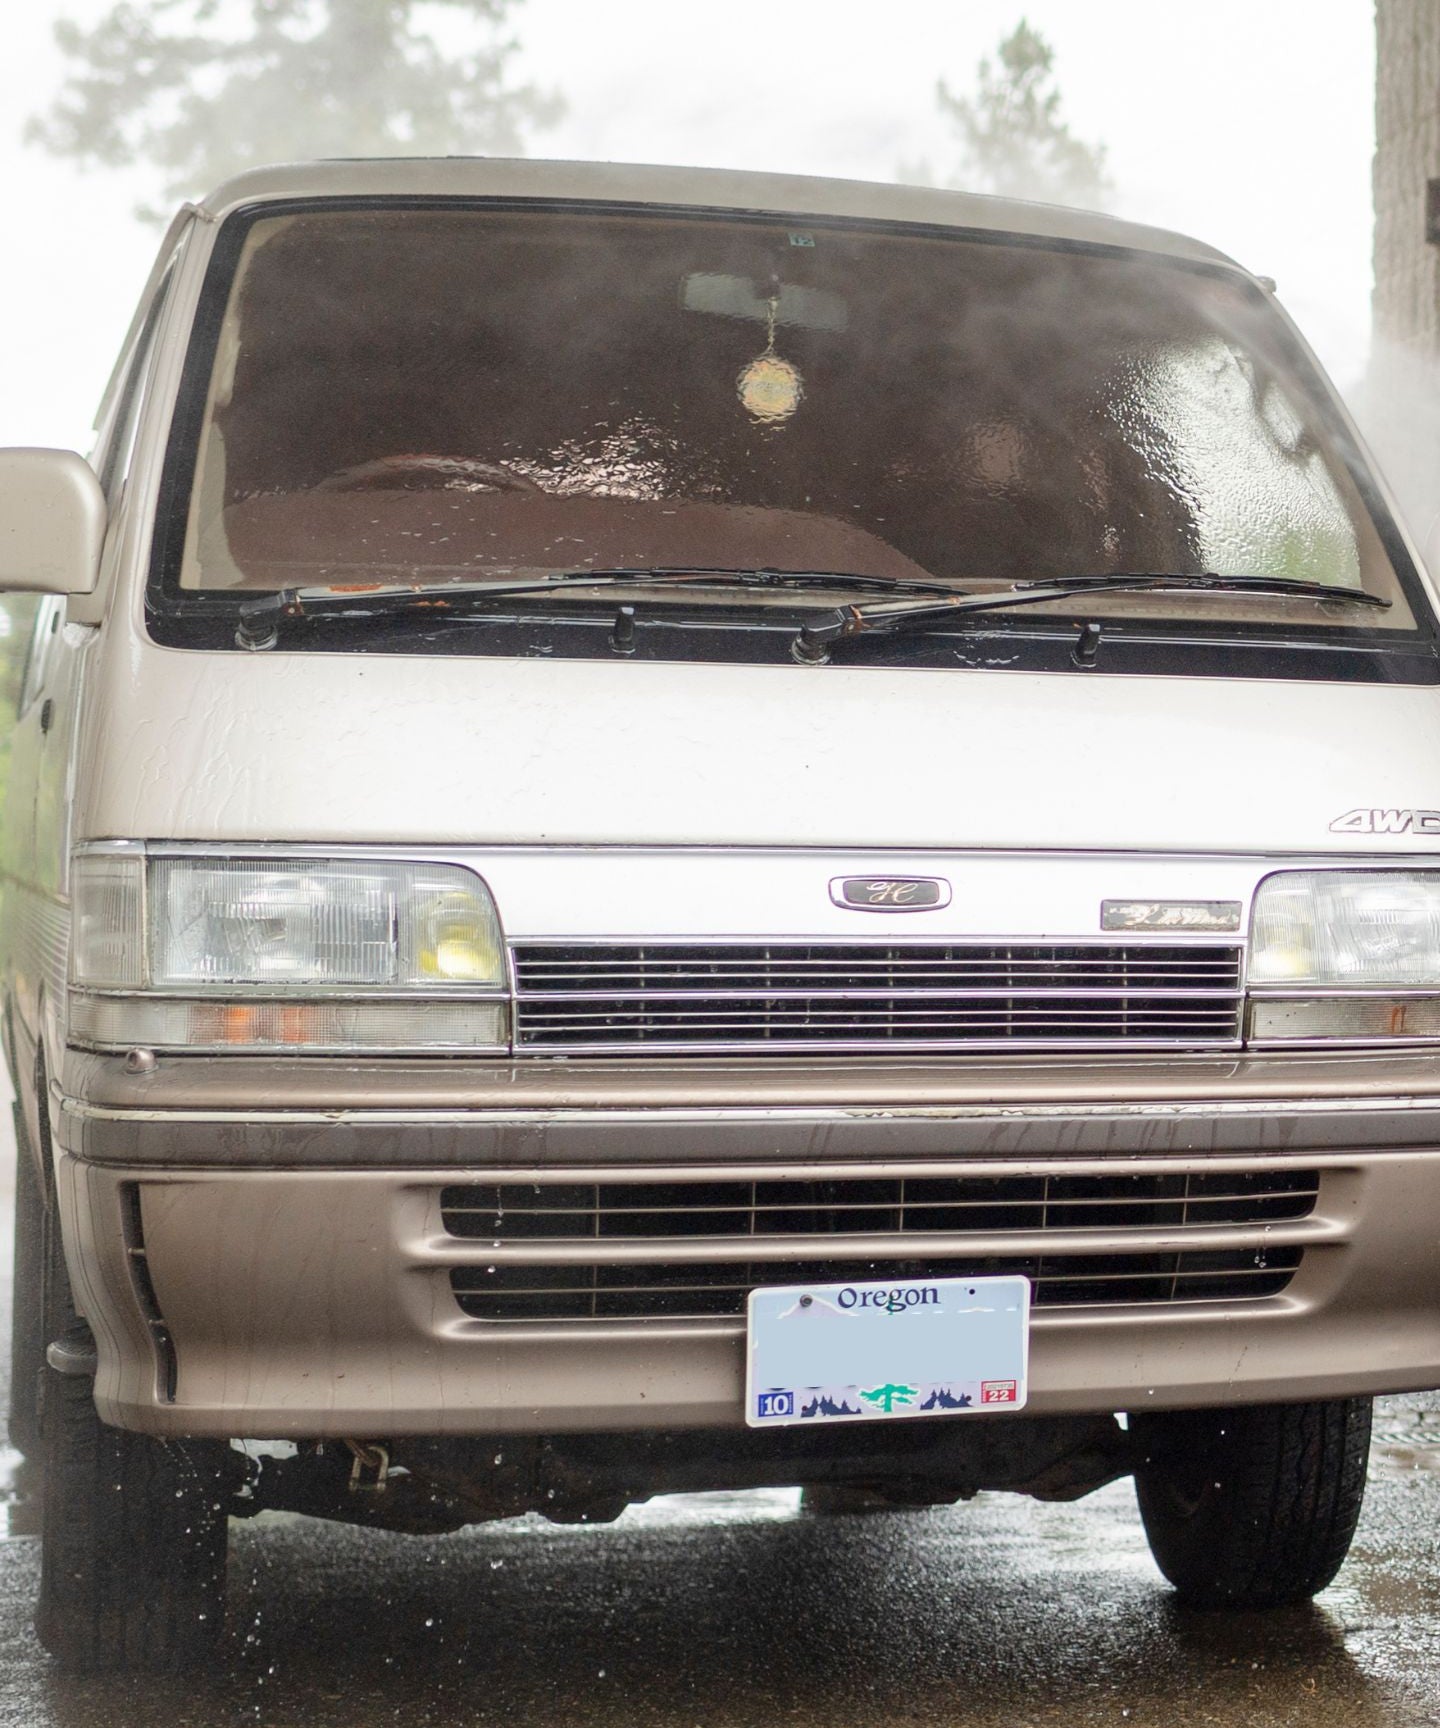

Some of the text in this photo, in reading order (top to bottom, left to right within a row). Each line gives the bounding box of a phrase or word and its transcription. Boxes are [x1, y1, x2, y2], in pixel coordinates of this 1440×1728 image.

[838, 1287, 941, 1312] Oregon
[764, 1394, 789, 1415] 10
[988, 1390, 1009, 1401] 22
